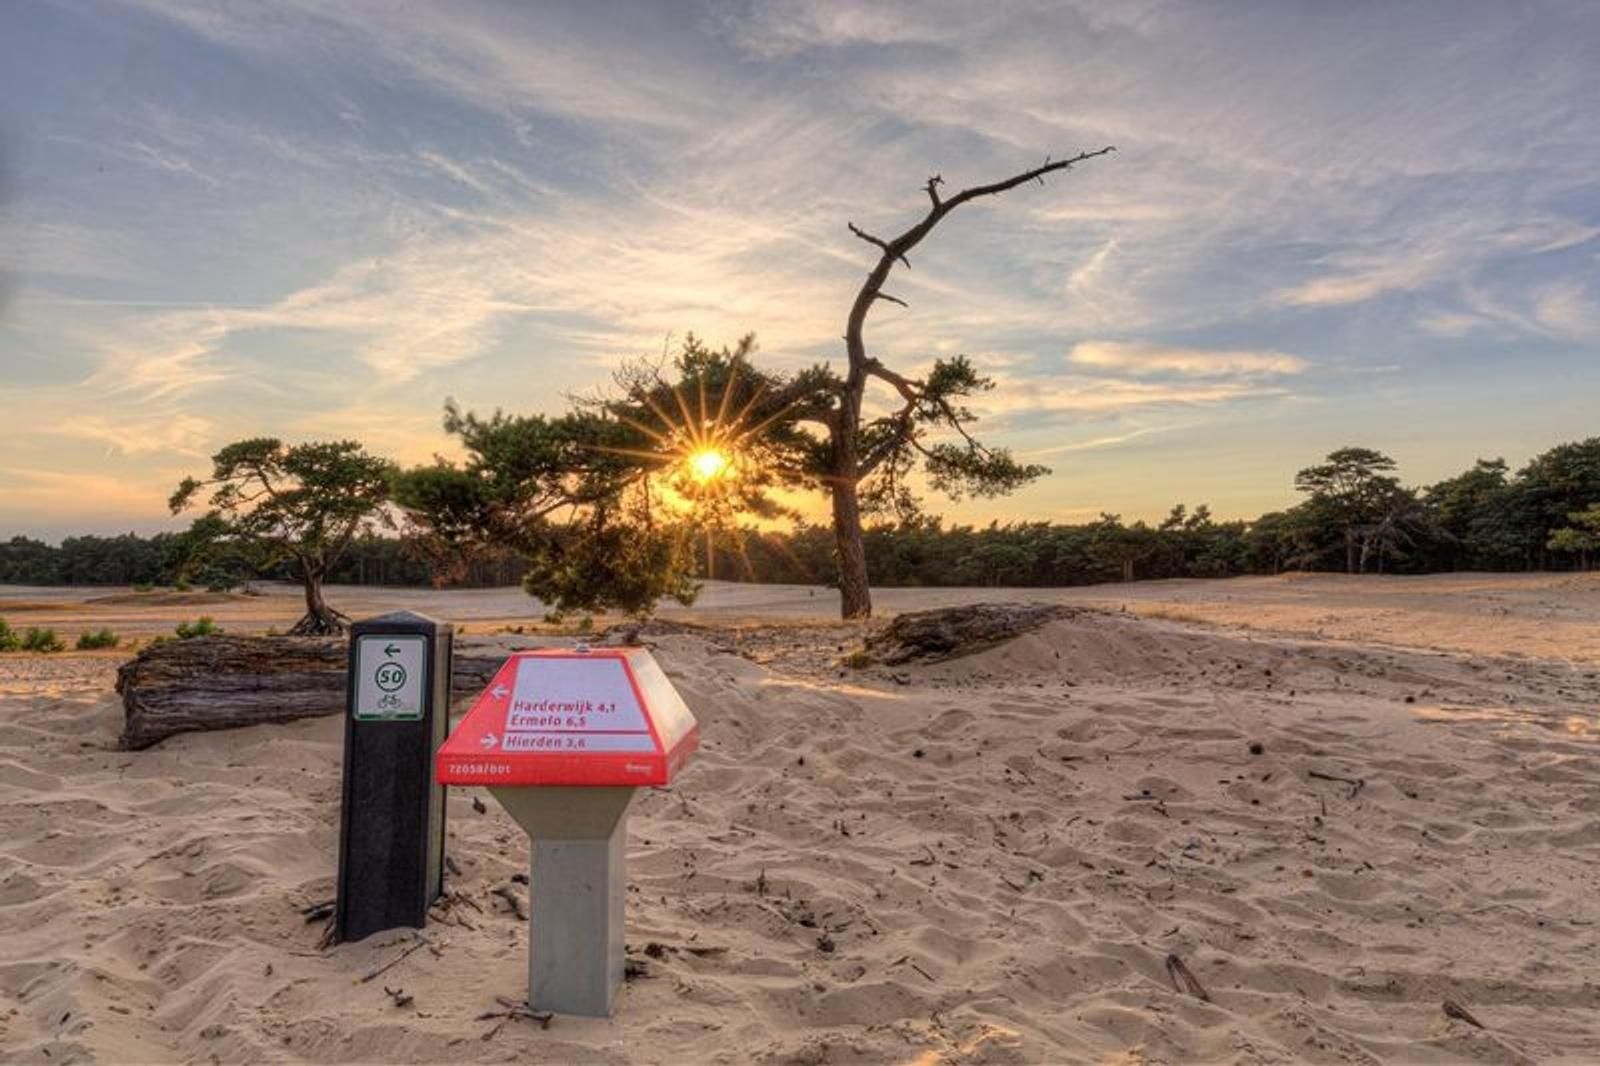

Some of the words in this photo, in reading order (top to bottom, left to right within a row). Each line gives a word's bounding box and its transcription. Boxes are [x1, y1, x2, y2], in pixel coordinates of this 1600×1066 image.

[380, 670, 402, 683] 50
[513, 699, 593, 714] Harderwijk
[597, 703, 616, 713] 4,1
[511, 714, 562, 727] Ermelo
[566, 717, 587, 728] 6,5
[507, 736, 562, 748] Hierden
